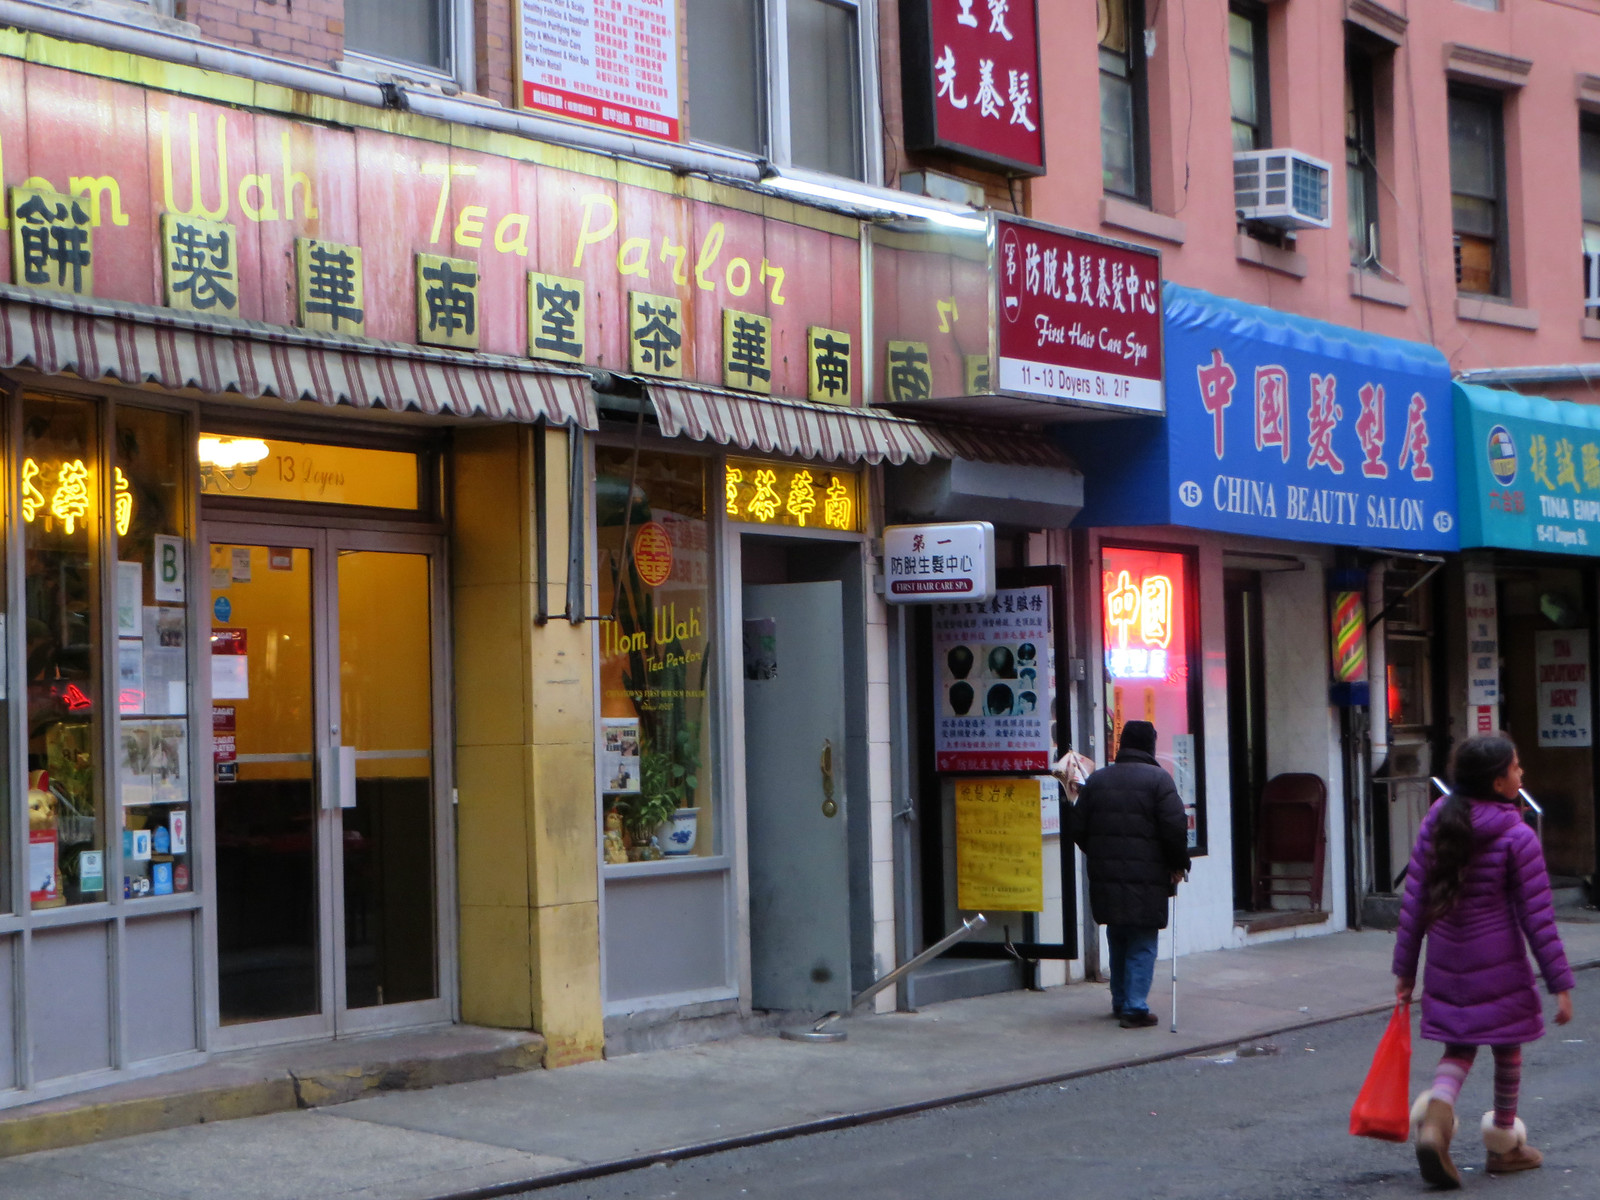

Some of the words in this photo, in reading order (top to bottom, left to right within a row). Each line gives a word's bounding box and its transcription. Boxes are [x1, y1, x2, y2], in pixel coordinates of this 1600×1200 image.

[162, 113, 319, 223] Wah
[573, 193, 786, 307] Parlor
[1035, 314, 1065, 347] First
[1068, 322, 1095, 350] Hair
[1099, 327, 1122, 354] Care
[1123, 332, 1148, 366] Spa
[1059, 370, 1091, 397] Doyers
[1096, 376, 1109, 396] St.
[1114, 378, 1130, 399] 2/F
[276, 455, 296, 482] 13
[1213, 474, 1277, 518] CHINA
[1286, 485, 1359, 526] BEAUTY
[1367, 495, 1425, 531] SALON
[1540, 495, 1570, 519] TINA
[162, 543, 177, 583] B
[896, 582, 915, 592] FIRST
[917, 582, 933, 591] HAIR
[935, 581, 954, 591] CARE
[955, 581, 968, 590] SPA
[654, 602, 701, 644] Wah
[646, 656, 664, 672] Tea
